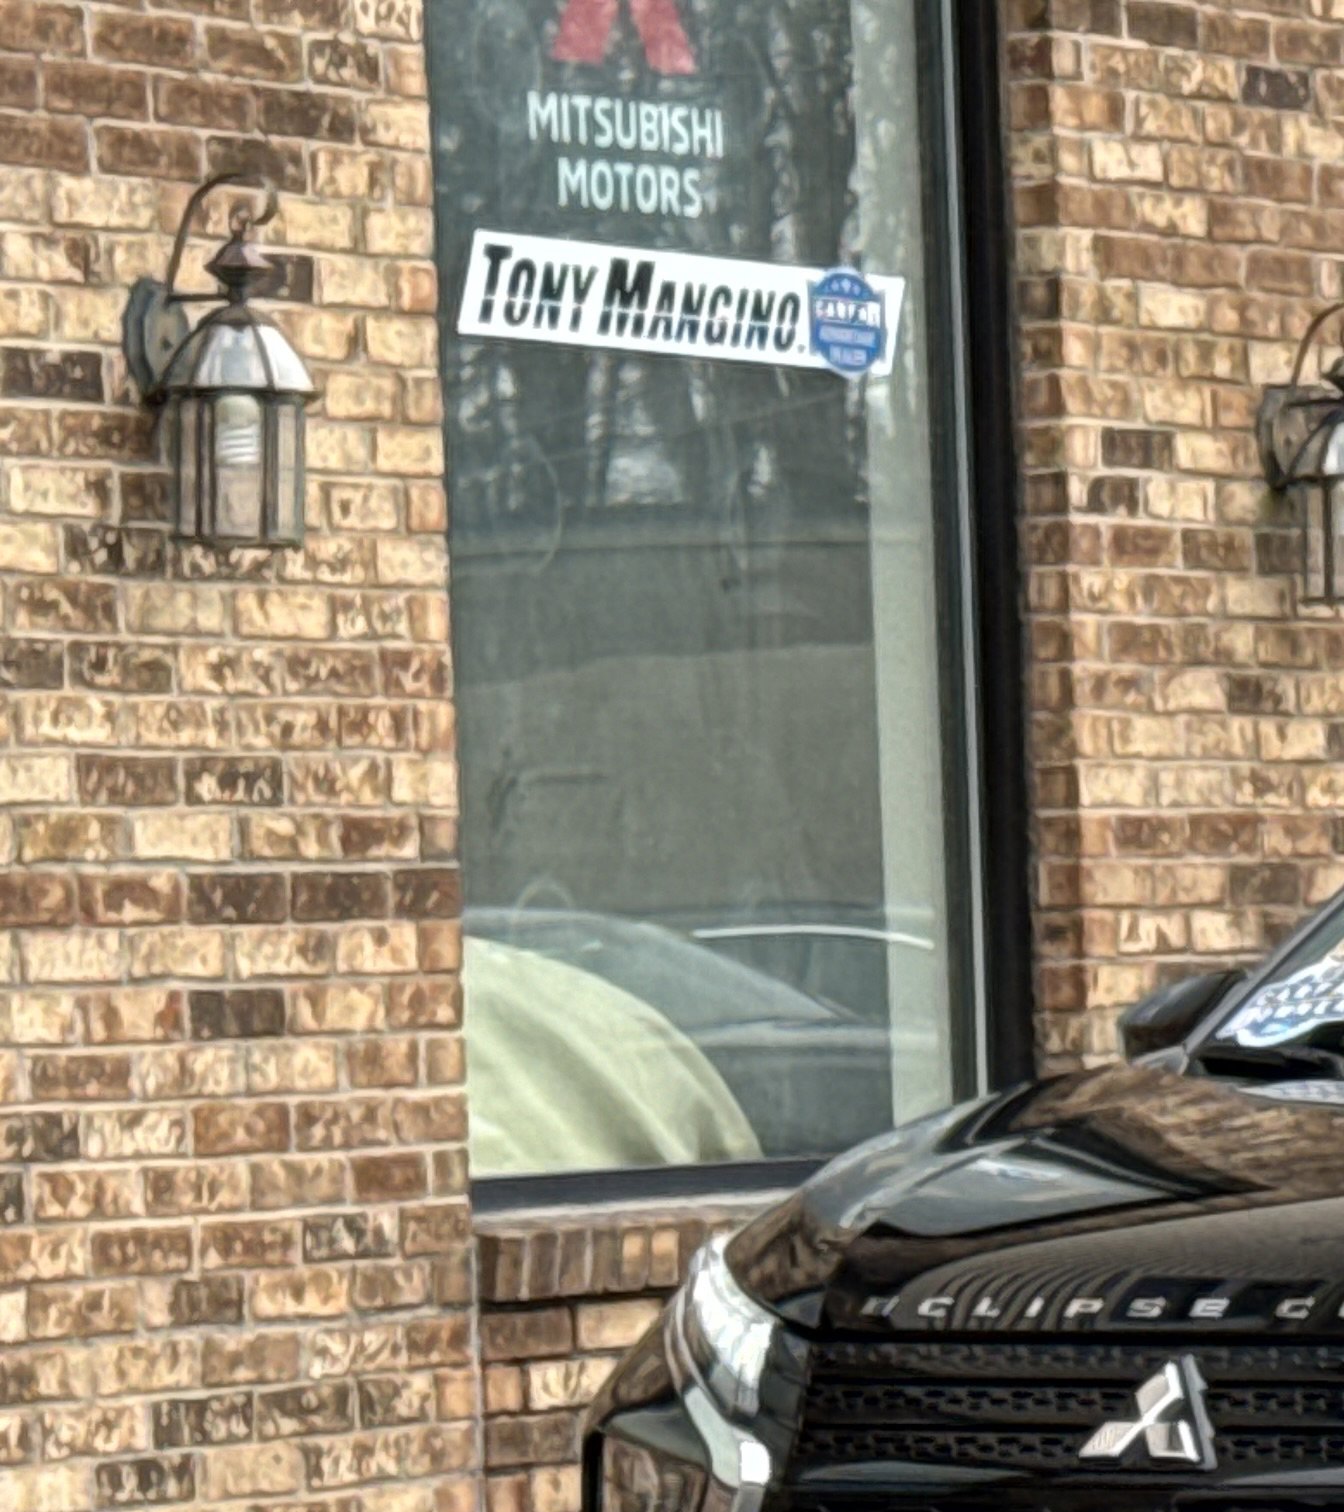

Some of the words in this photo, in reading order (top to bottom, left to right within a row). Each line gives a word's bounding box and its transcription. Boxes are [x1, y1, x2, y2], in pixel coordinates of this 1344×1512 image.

[527, 91, 724, 159] MITSUBISHI
[557, 156, 702, 219] MOTORS
[478, 242, 599, 333] TONY
[596, 256, 802, 354] MANGINO
